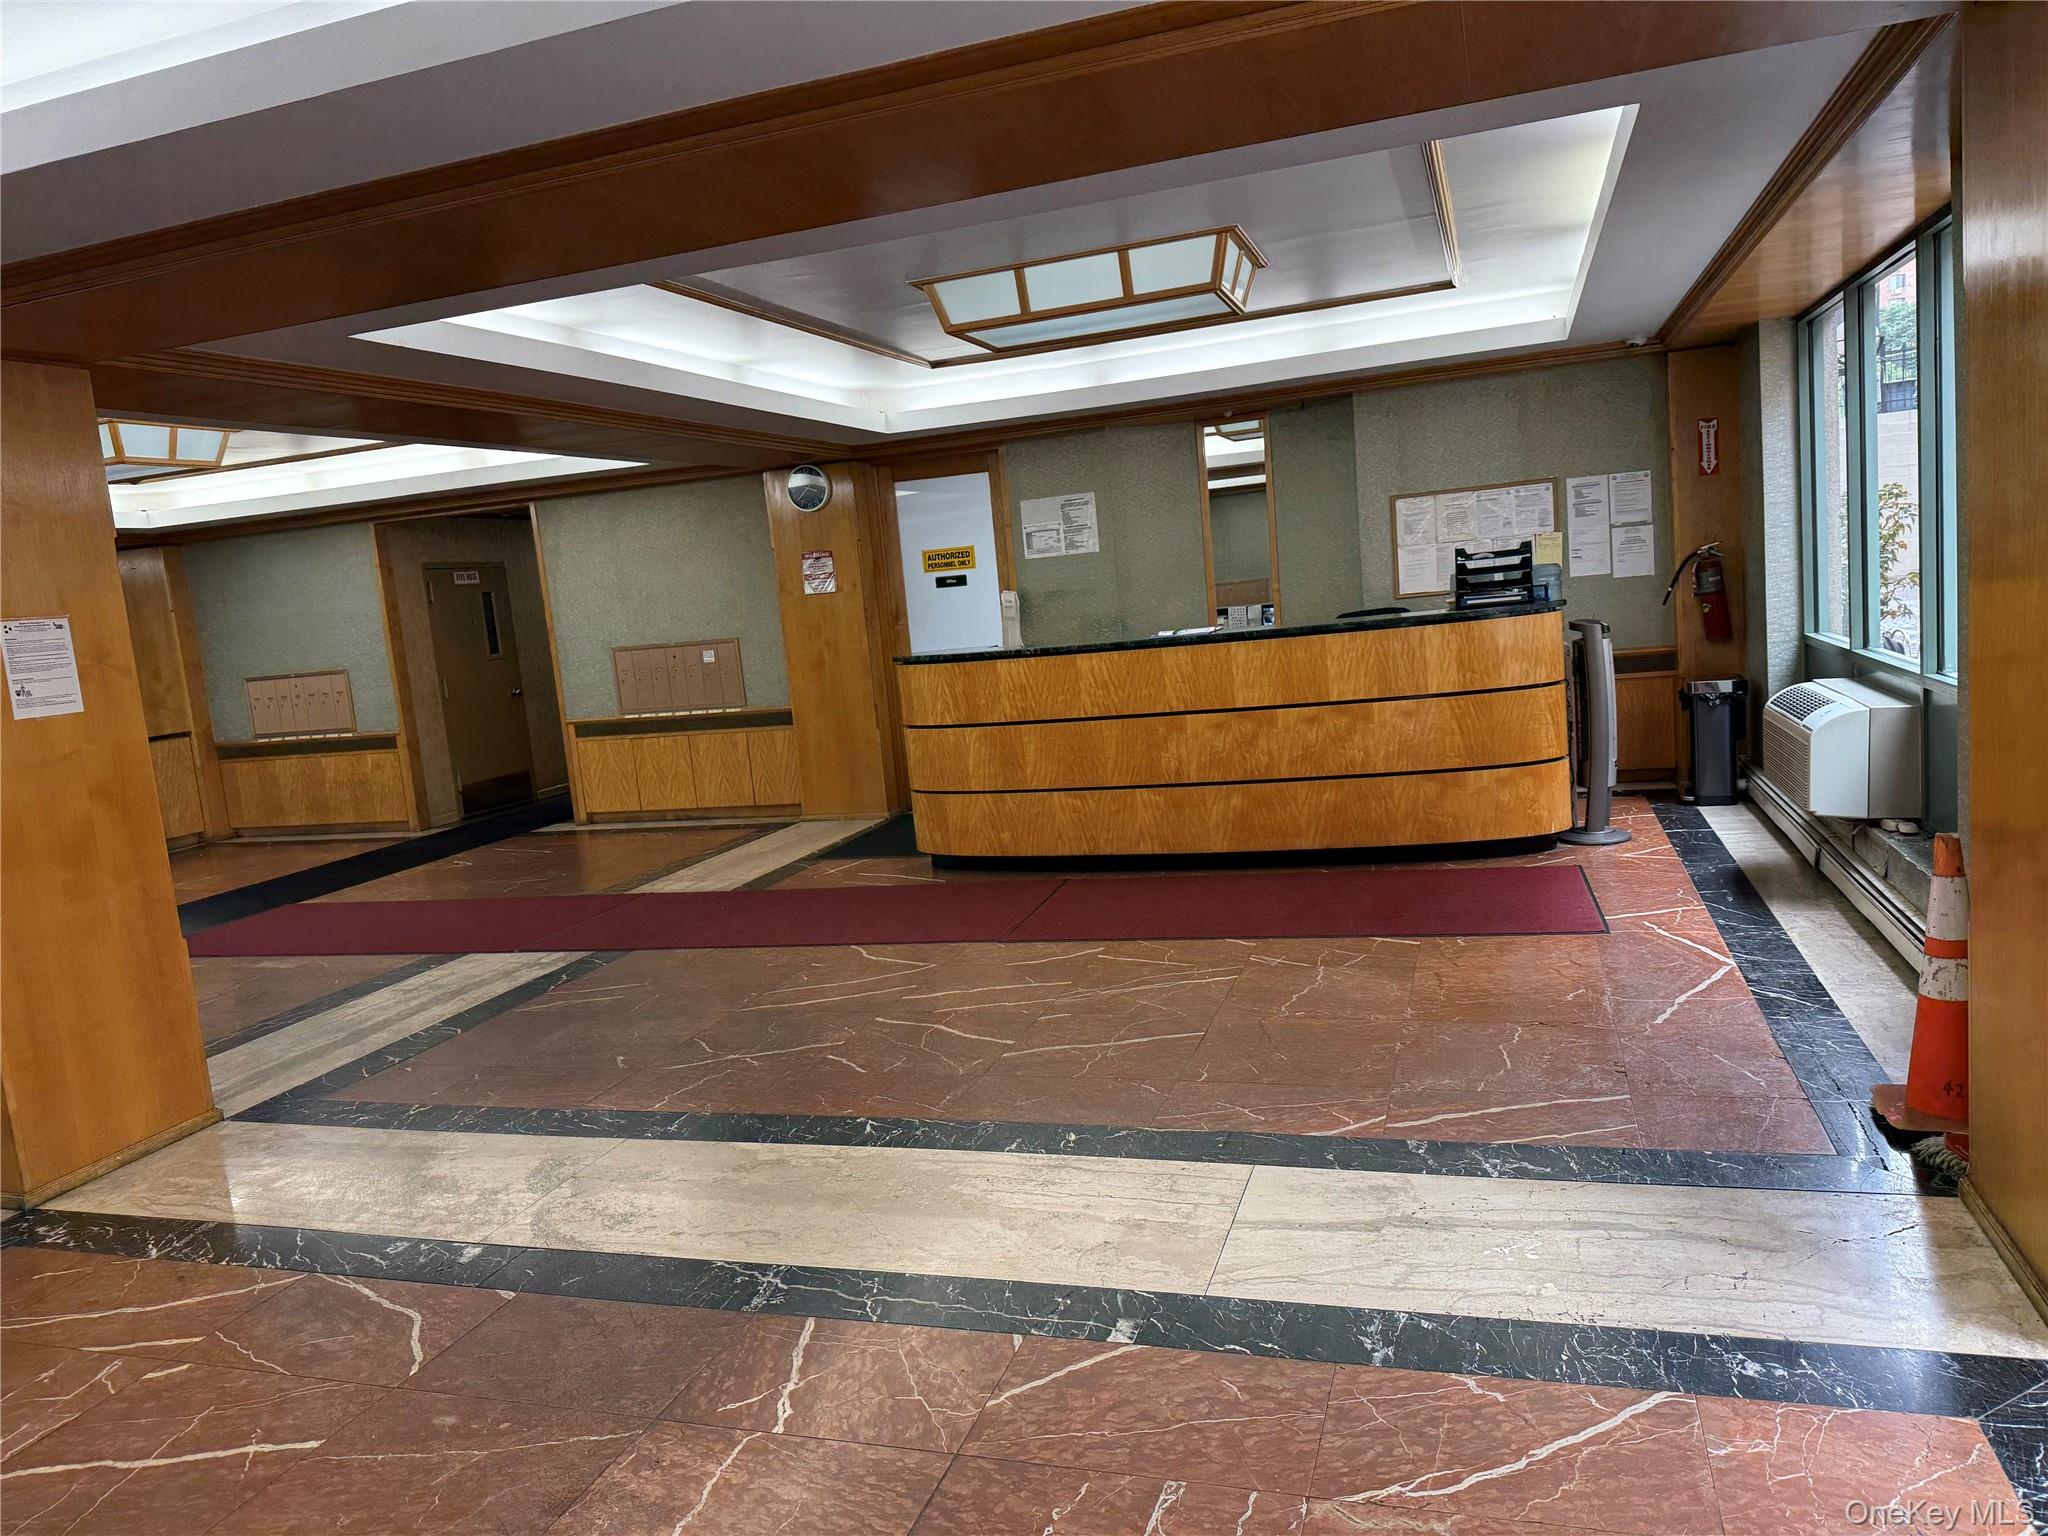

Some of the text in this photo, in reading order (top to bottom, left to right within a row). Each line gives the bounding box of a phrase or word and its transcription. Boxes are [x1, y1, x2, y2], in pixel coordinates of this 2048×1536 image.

[927, 550, 971, 562] AUTHORIZED
[927, 559, 971, 570] PERSONNEL ONLY
